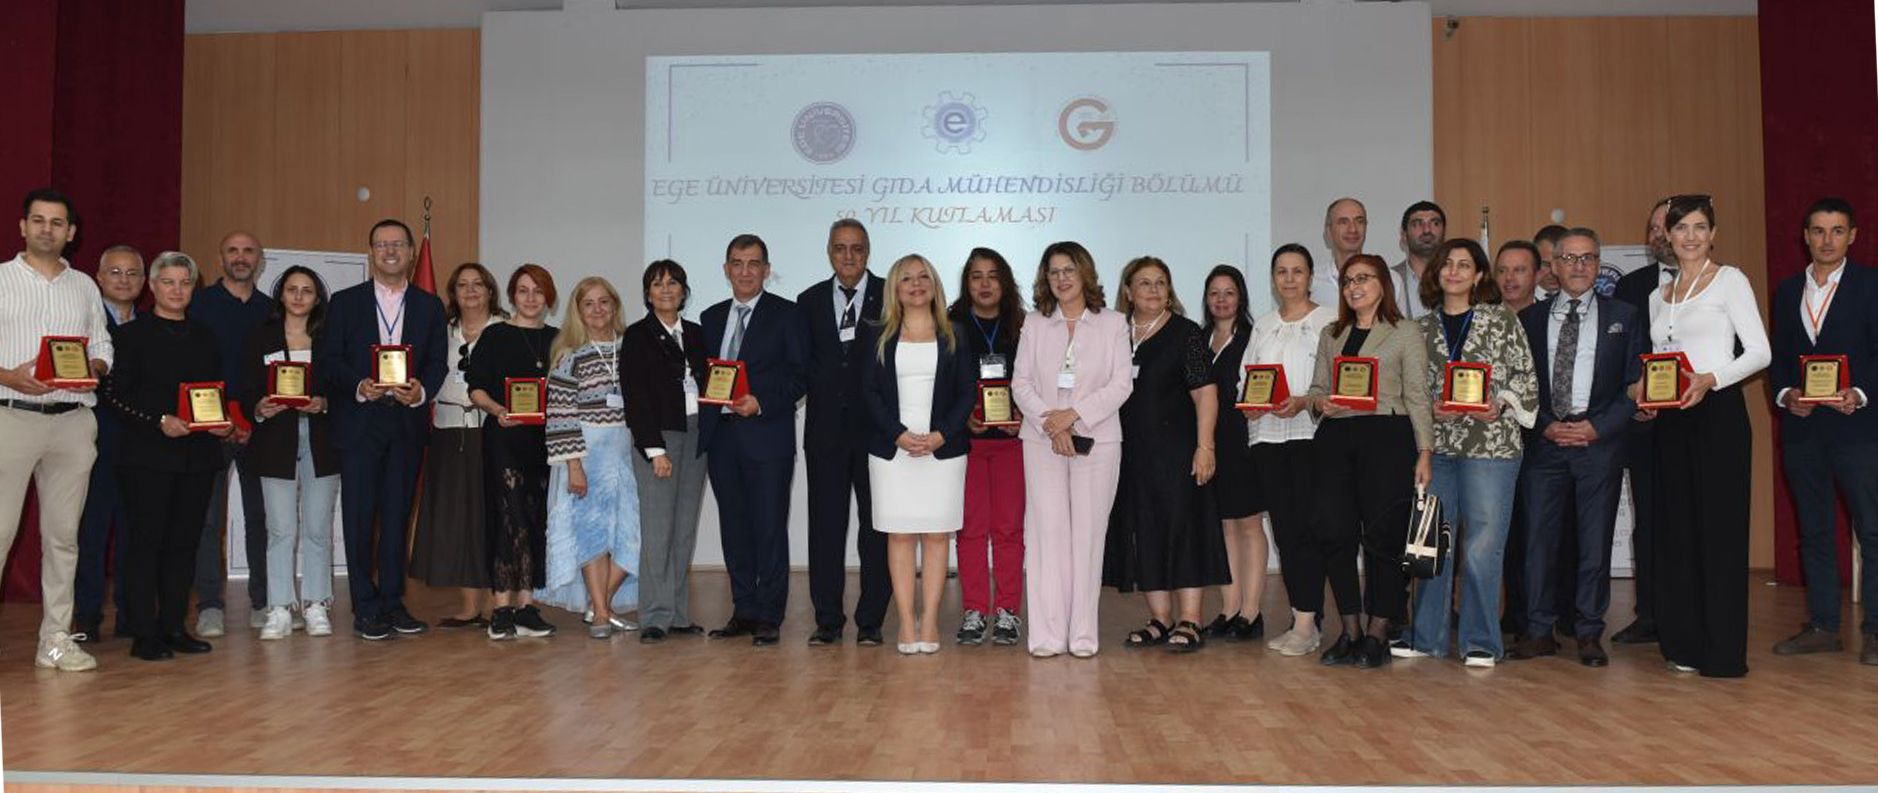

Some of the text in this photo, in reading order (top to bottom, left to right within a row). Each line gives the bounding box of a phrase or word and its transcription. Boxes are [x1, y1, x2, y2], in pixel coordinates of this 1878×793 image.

[1058, 98, 1114, 151] G
[652, 173, 1245, 204] EGE ÜNİVERSİTESİ GIDA MÜHENDİSLİĞİ BÖLÜMÜ
[864, 206, 904, 223] YIL
[910, 205, 1057, 229] KUTLAMASI
